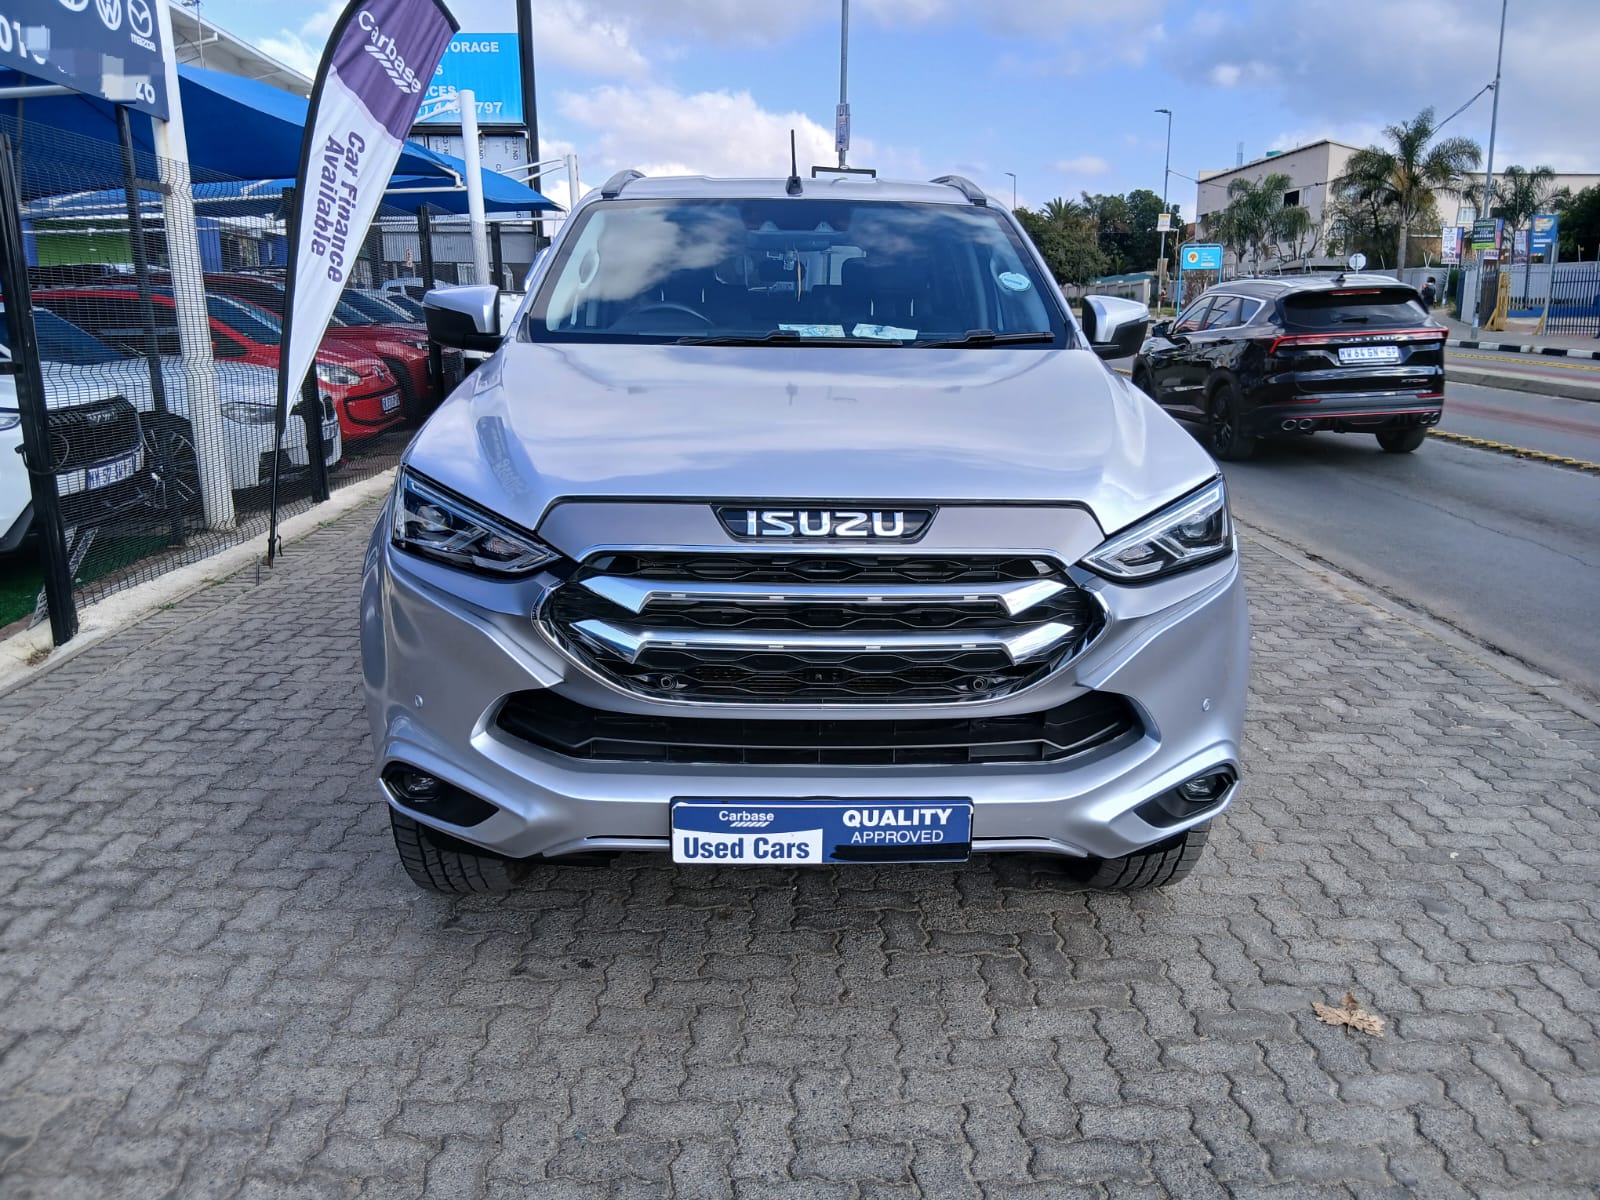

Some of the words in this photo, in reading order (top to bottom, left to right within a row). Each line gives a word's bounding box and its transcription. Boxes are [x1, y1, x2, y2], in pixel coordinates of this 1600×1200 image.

[358, 10, 421, 93] Carbase
[344, 131, 366, 177] Car
[311, 135, 345, 257] Available
[327, 180, 358, 283] Finance
[747, 510, 904, 536] ISUZU
[718, 810, 775, 822] Carbase
[842, 808, 952, 827] QUALITY
[683, 837, 744, 859] Used
[753, 837, 810, 859] Cars
[851, 830, 944, 844] APPROVED
